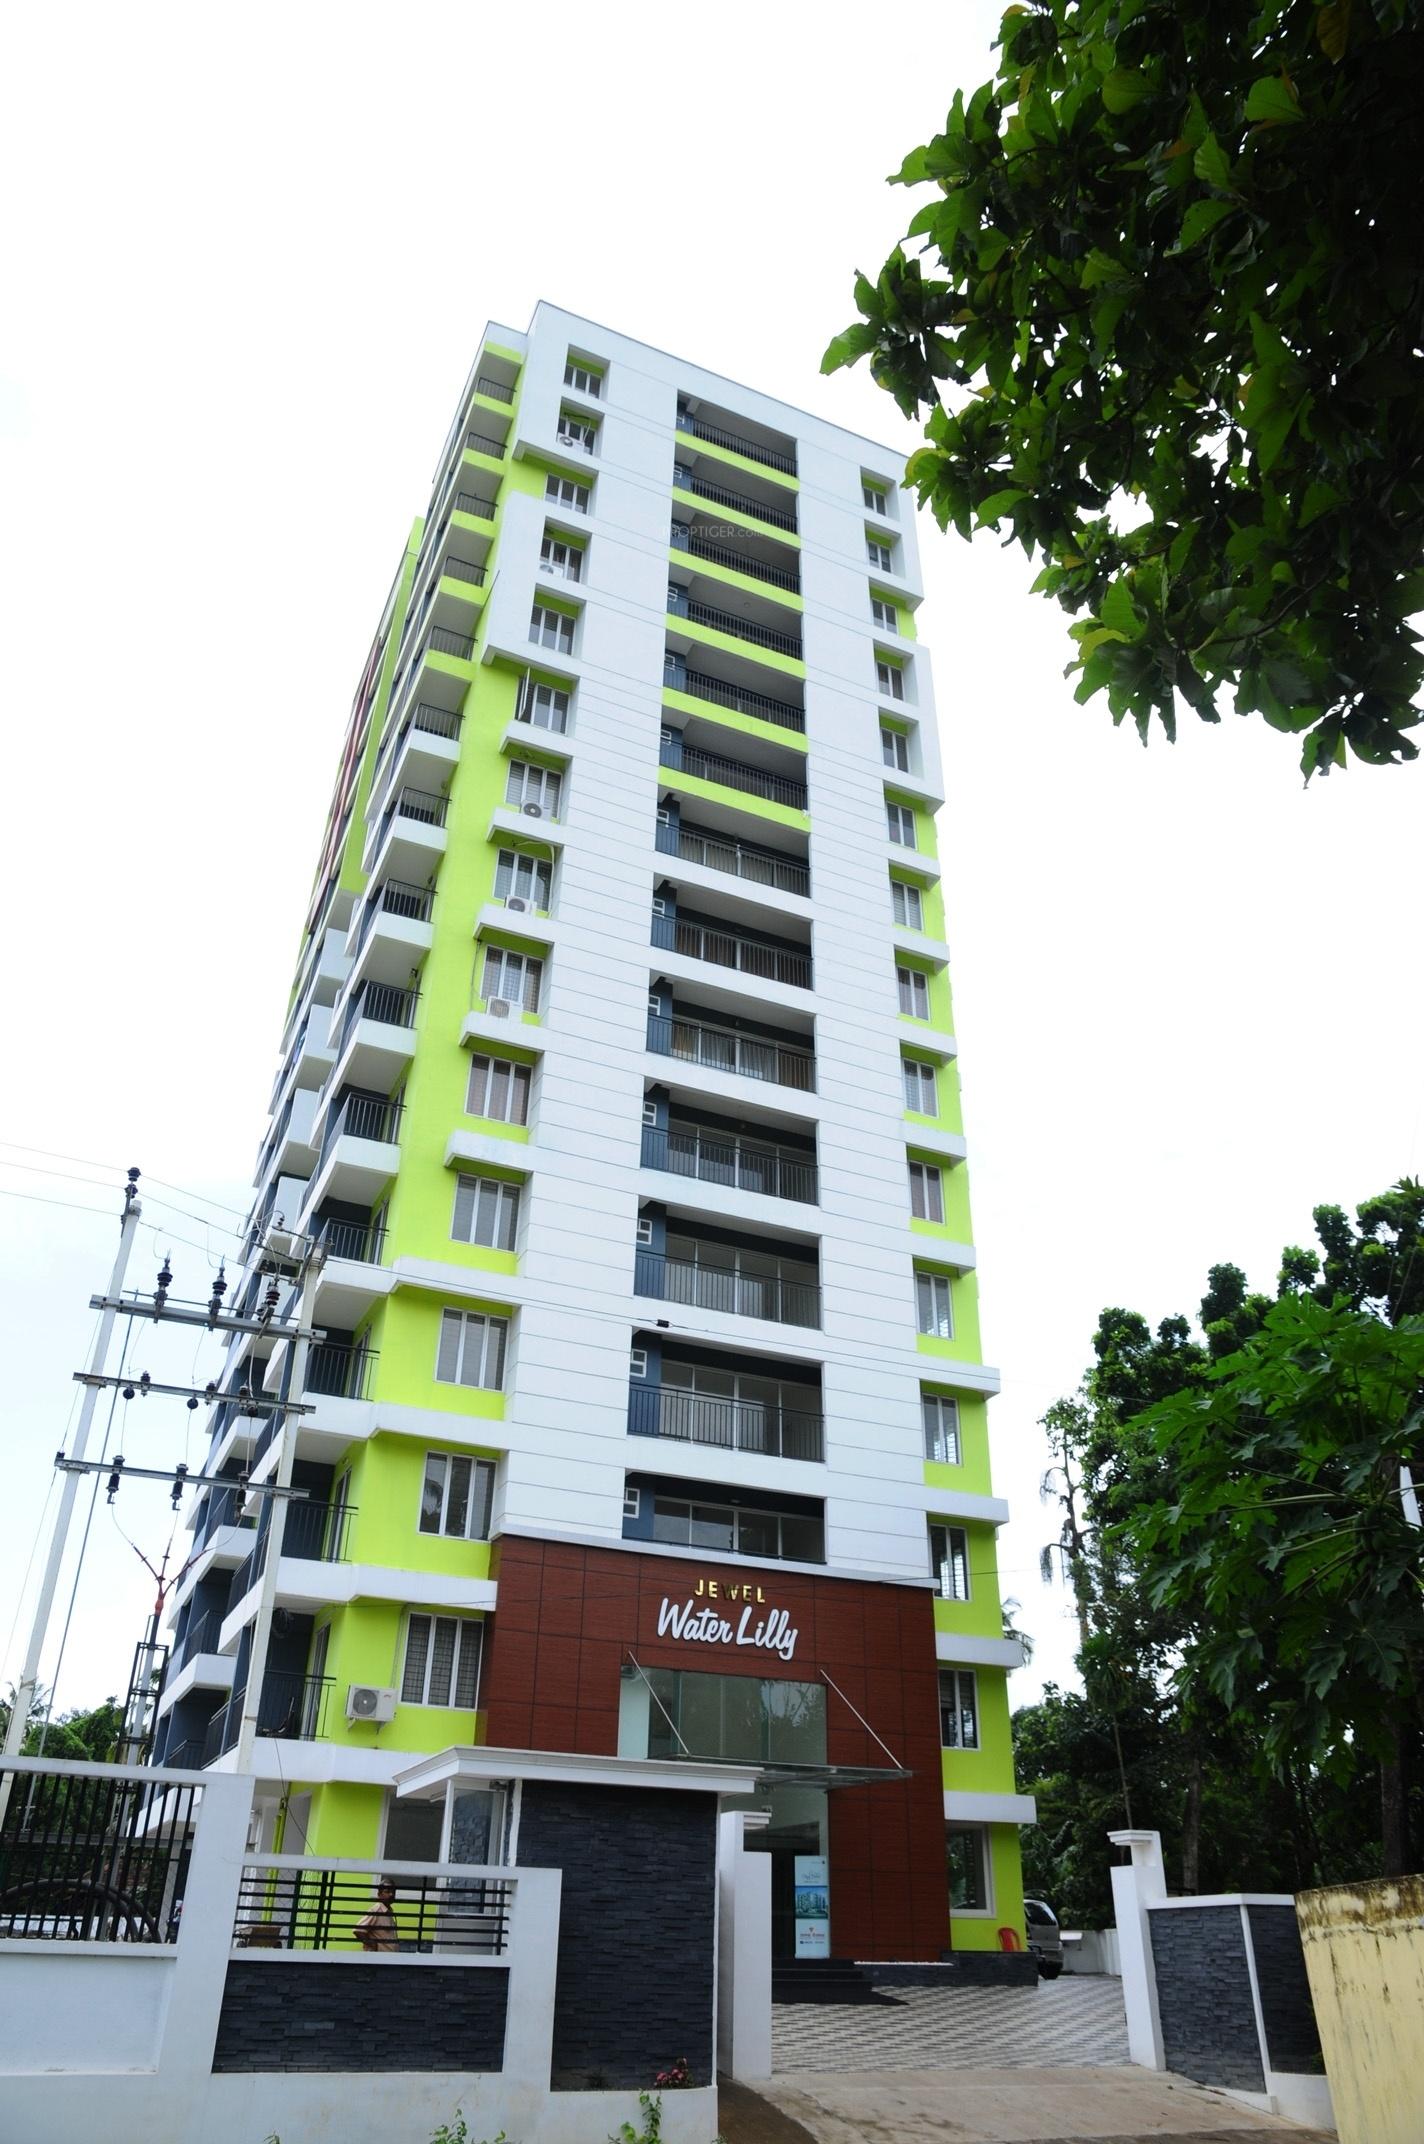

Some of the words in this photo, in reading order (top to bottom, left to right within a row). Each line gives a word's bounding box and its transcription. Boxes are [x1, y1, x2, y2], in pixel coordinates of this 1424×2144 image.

[694, 1579, 765, 1603] JEWEL
[657, 1598, 733, 1644] Water
[736, 1606, 798, 1660] Lilly
